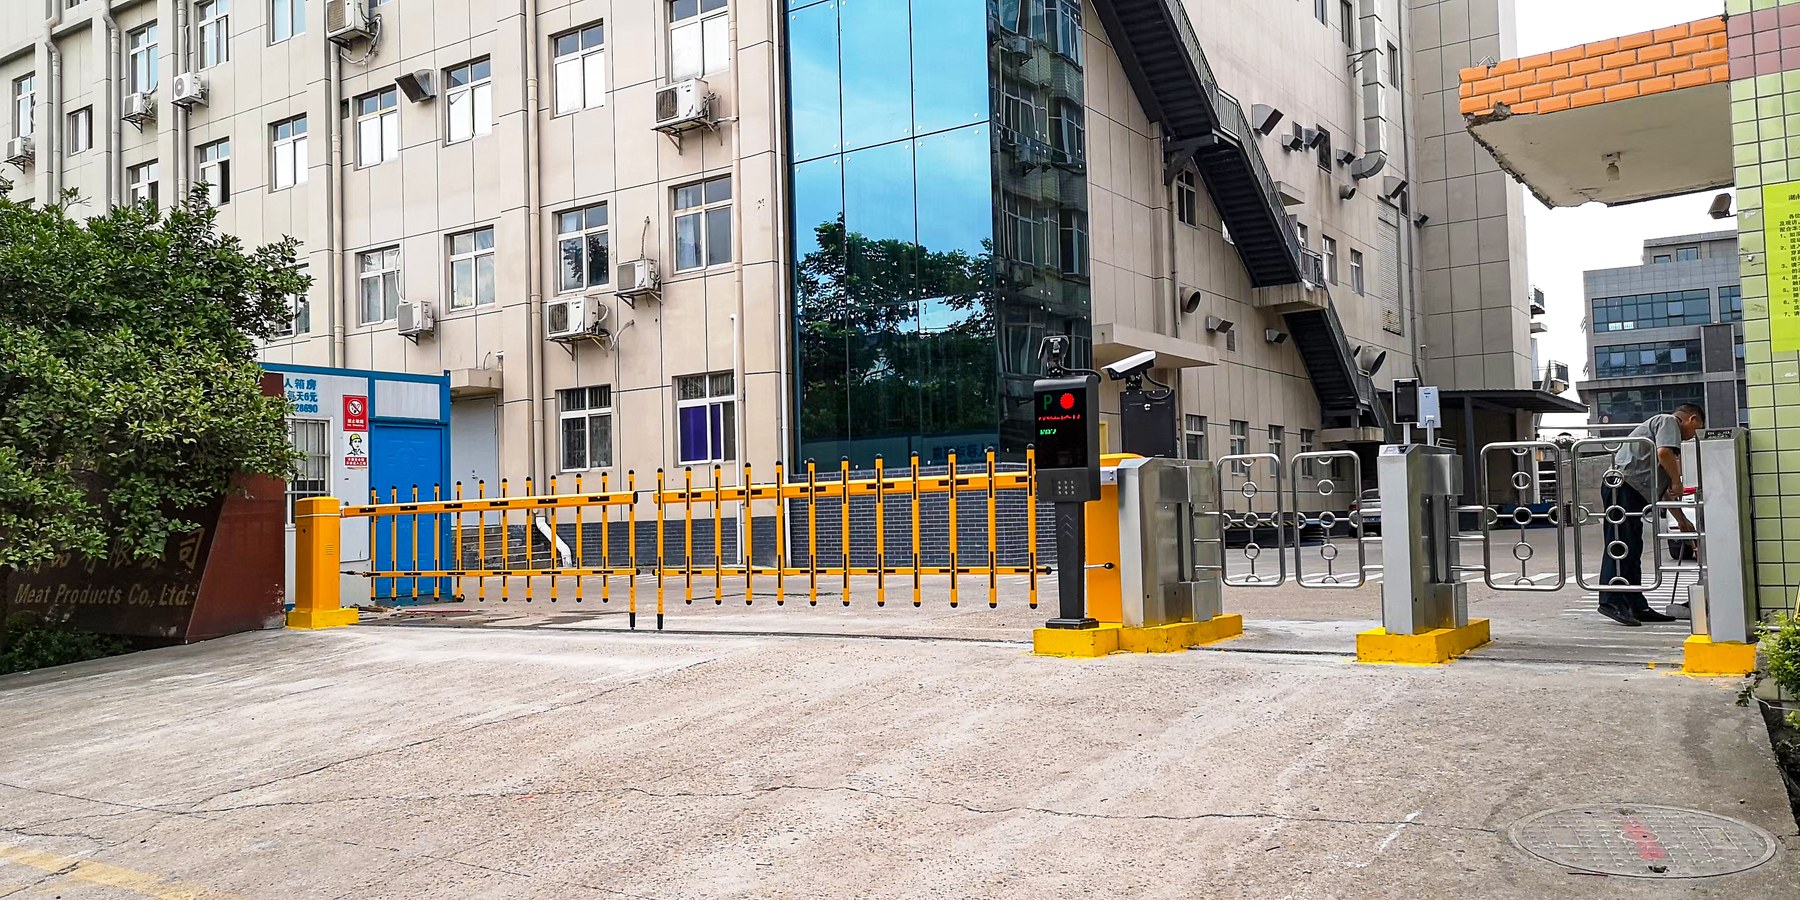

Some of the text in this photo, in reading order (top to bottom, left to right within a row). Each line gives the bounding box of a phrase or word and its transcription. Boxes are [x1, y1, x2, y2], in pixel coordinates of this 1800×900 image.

[1043, 394, 1053, 410] P
[15, 583, 51, 605] Meat
[55, 584, 122, 606] Products
[159, 583, 189, 607] Ltd.
